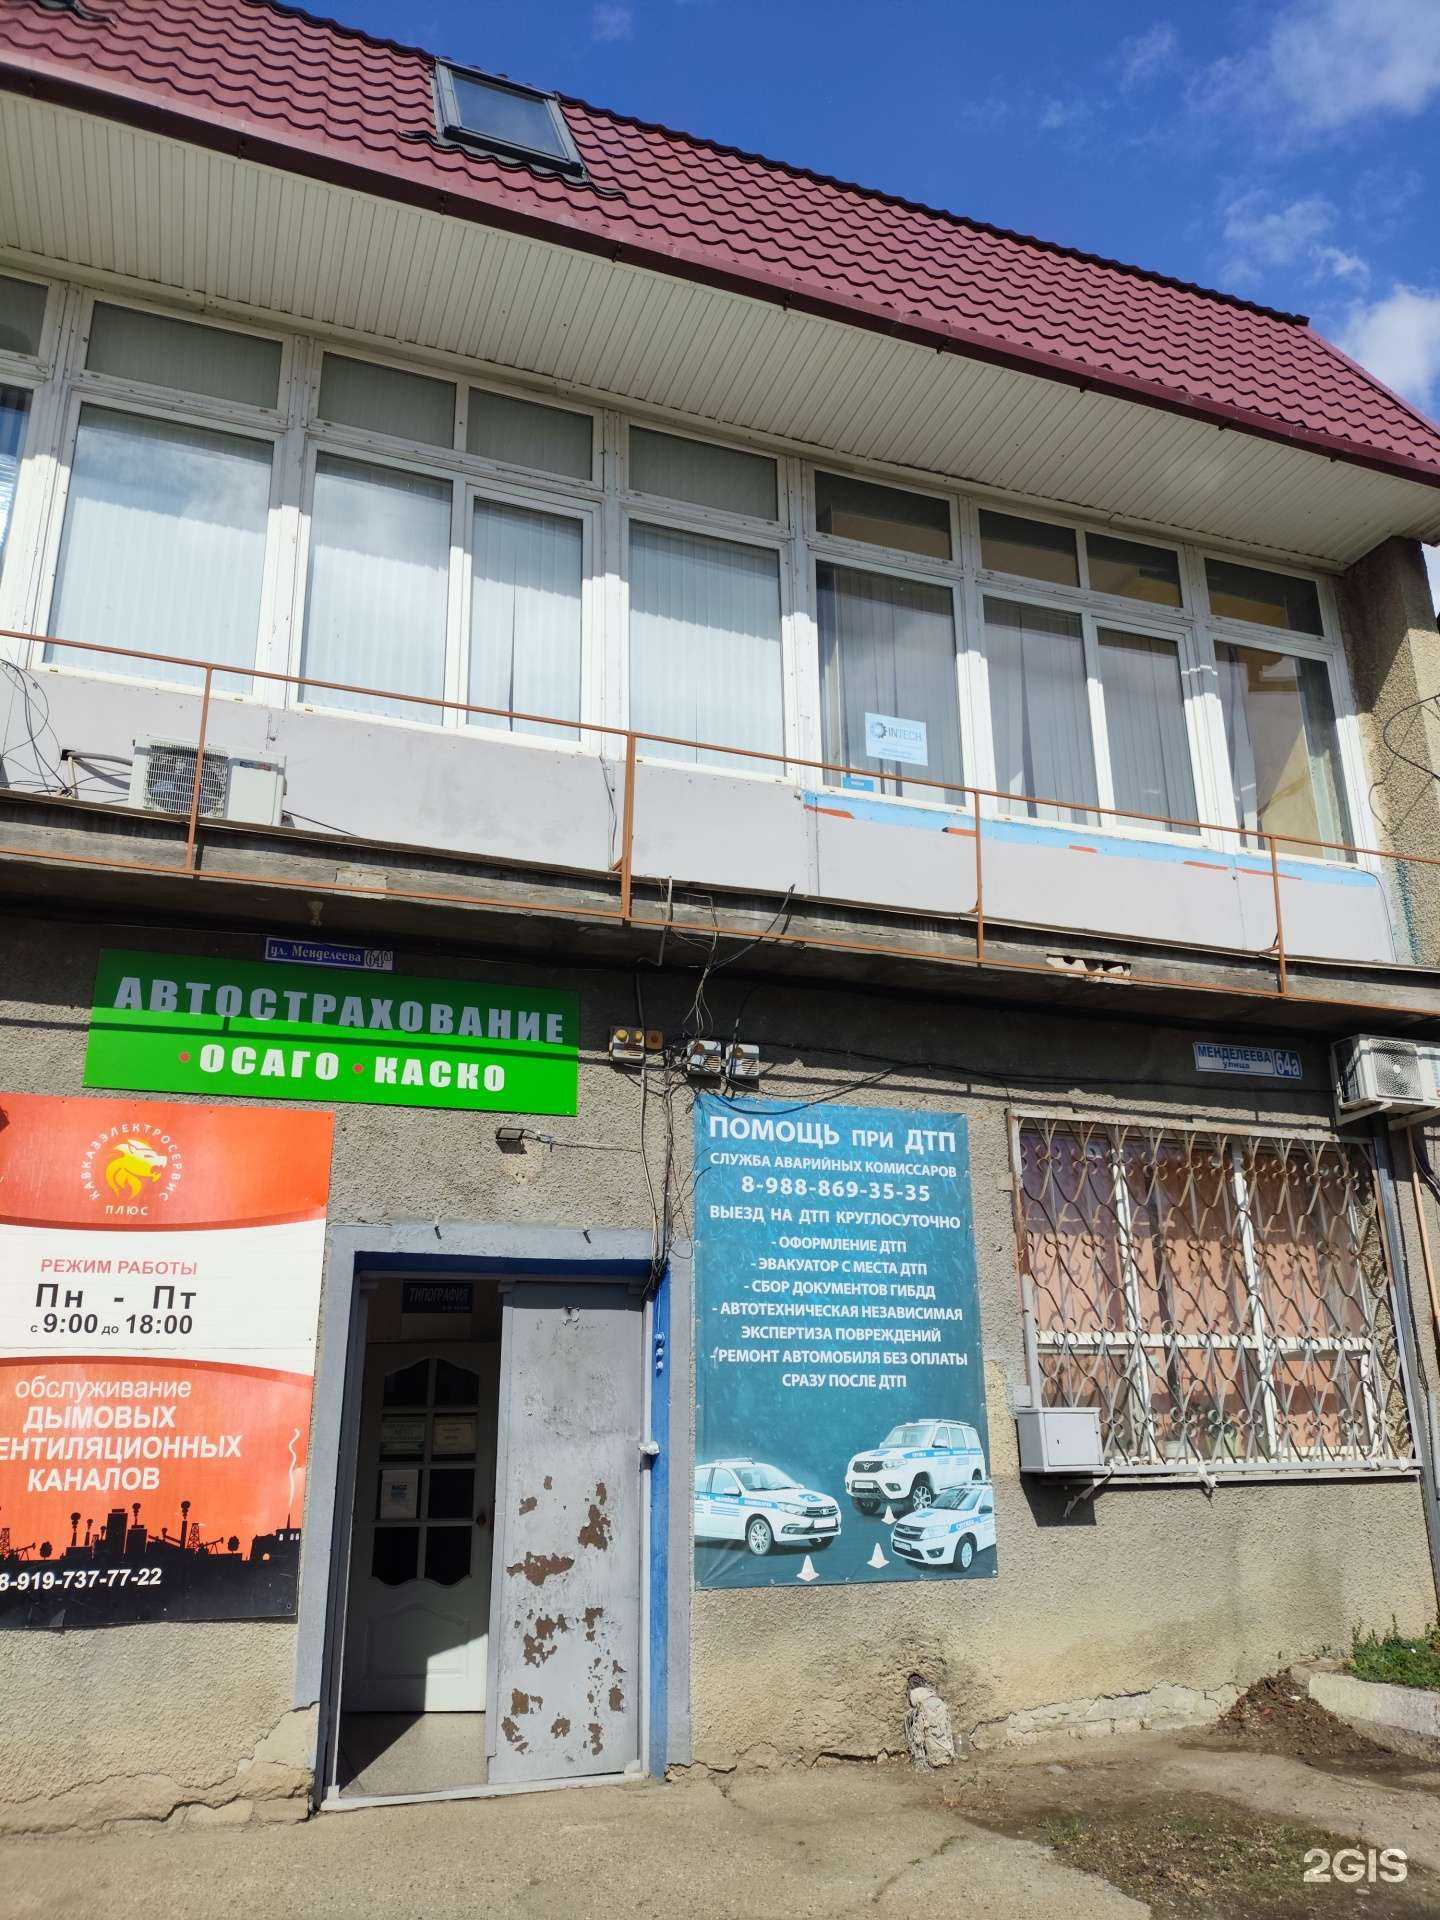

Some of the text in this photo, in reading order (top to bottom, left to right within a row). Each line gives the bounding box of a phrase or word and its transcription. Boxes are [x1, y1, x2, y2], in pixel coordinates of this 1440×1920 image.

[271, 945, 288, 957] ул.
[292, 944, 361, 962] Менделеева
[113, 976, 563, 1044] АВТОСТРАХОВАНИЕ
[1197, 1045, 1272, 1063] МЕНДЕЛЕЕВА
[200, 1044, 506, 1092] ОСАГО КАСКО
[709, 1115, 956, 1153] ПОМОЩЬ ПРИ ДТП
[710, 1152, 957, 1178] СЛУЖБА АВАРИЙНЫХ КОМИССАРОВ
[741, 1176, 930, 1202] 8-988-869-35-35
[105, 1204, 149, 1216] ПЛЮС
[710, 1205, 960, 1229] ВЫЕЗД НА ДТП КРУГЛОСУТОЧНО
[779, 1236, 877, 1252] ОФОРМЛЕНИЕ
[880, 1239, 907, 1253] ДТП
[40, 1258, 197, 1275] РЕЖИМ РАБОТЫ
[841, 1261, 850, 1273] С
[853, 1261, 898, 1275] МЕСТА
[900, 1262, 927, 1277] ДТП
[36, 1283, 83, 1308] Пн
[153, 1285, 197, 1309] Пт
[752, 1280, 790, 1293] СБОР
[792, 1281, 887, 1297] ДОКУМЕНТОВ
[890, 1284, 936, 1300] ГИБДД
[30, 1313, 193, 1336] с 9:00 до 18:00
[862, 1306, 963, 1320] НЕЗАВИСИМАЯ
[741, 1326, 942, 1344] ЭКСПЕРТИЗА ПОВРЕЖДЕНИЙ
[782, 1350, 881, 1364] АВТОМОБИЛЯ
[883, 1352, 908, 1365] БЕЗ
[910, 1352, 968, 1366] ОПЛАТЫ
[15, 1375, 192, 1402] обслуживание
[782, 1374, 907, 1389] СРАЗУ ПОСЛЕ ДТП
[23, 1405, 176, 1433] ДЫМОВЫХ
[27, 1467, 160, 1492] КАНАЛОВ
[0, 1567, 162, 1592] 8-919-737-77-22
